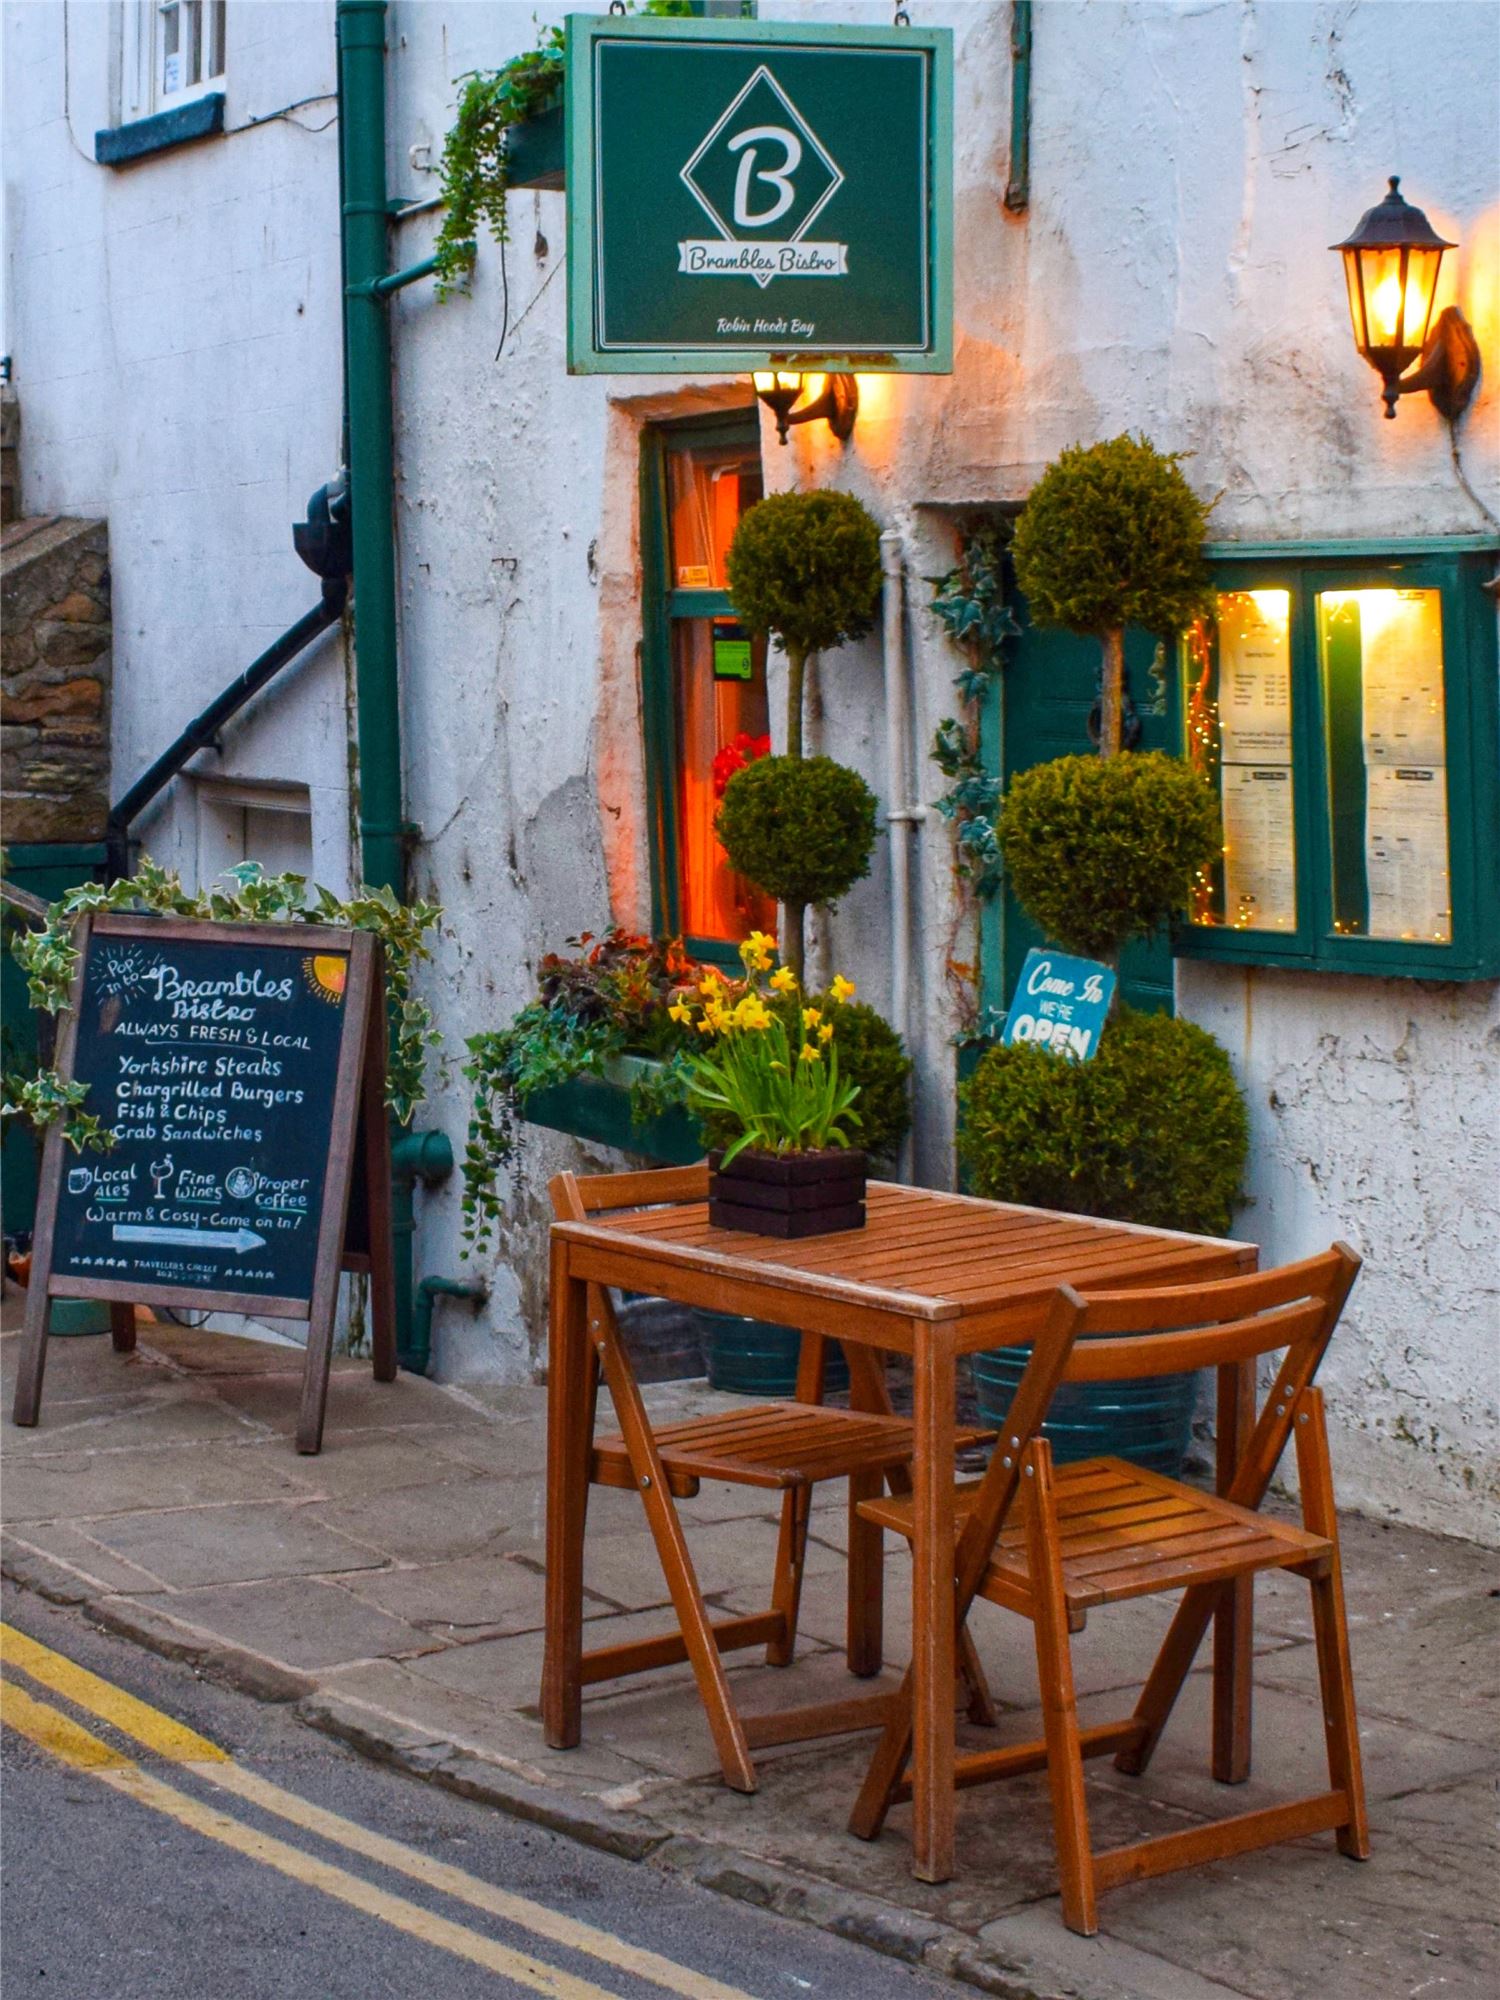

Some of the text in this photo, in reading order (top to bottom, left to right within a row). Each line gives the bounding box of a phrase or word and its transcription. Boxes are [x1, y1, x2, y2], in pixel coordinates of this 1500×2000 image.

[727, 125, 802, 227] B
[689, 246, 836, 272] Brambles Bistro
[717, 316, 815, 337] Robin Hoods Bay
[122, 972, 139, 985] to
[1027, 961, 1104, 1004] Come In
[114, 1022, 312, 1050] ALWAYS FRESH & LOCAL
[1011, 1014, 1092, 1060] OPEN
[118, 1055, 283, 1076] Yorkshire Steaks
[116, 1080, 304, 1108] Chargrilled Burgers
[117, 1101, 228, 1126] Fish & Chips
[114, 1122, 263, 1142] Crab Sandwiches
[93, 1163, 310, 1192] Local Fine Proper
[94, 1182, 308, 1208] Ales Wines Coffee
[86, 1206, 142, 1222] Warm
[145, 1207, 154, 1220] &
[255, 1217, 273, 1229] on
